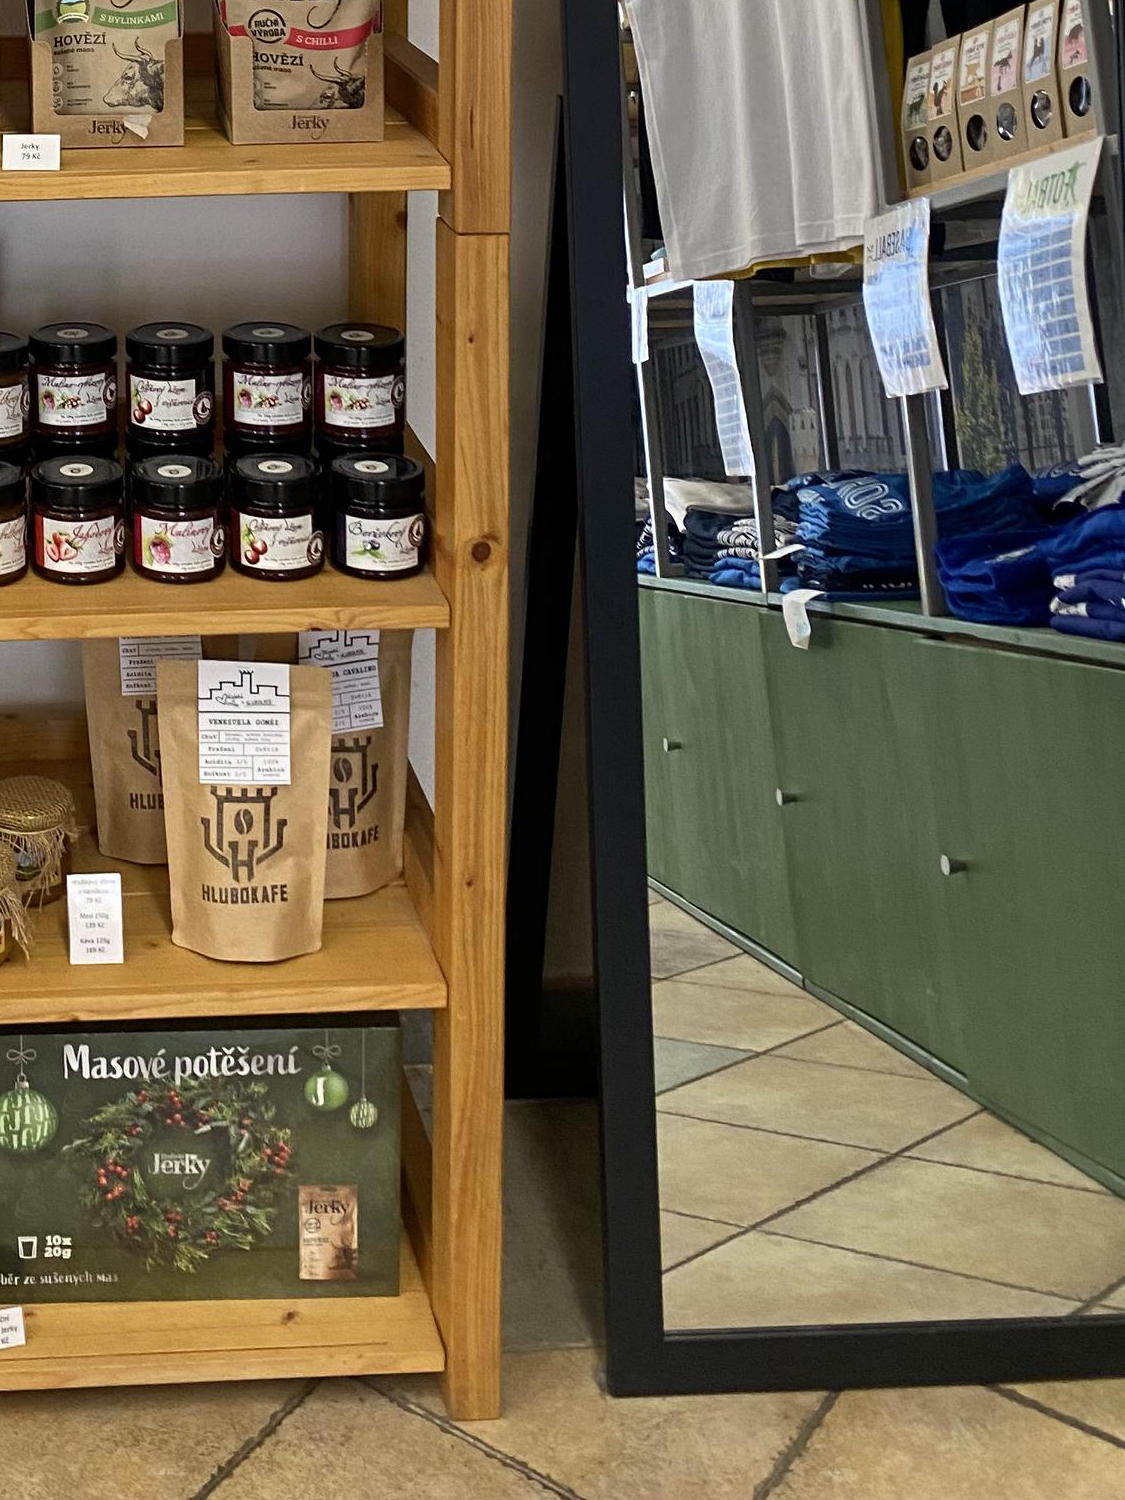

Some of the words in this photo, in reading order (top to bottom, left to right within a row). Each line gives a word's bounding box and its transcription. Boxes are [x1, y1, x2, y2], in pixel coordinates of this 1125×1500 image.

[99, 13, 106, 21] S
[107, 13, 164, 24] BYLINKAMI
[53, 31, 106, 47] HOVĚZÍ
[296, 35, 303, 43] S
[304, 36, 338, 46] CHILLI
[253, 52, 304, 67] HOVĚZÍ
[289, 115, 329, 140] Jerky
[21, 143, 40, 151] Jerky
[201, 884, 288, 905] HLUBOKAFE
[63, 1043, 167, 1082] Masové
[174, 1045, 302, 1084] potěšení
[148, 1152, 211, 1190] Jerky
[45, 1235, 72, 1246] 10x
[44, 1246, 72, 1259] 20g
[23, 1275, 36, 1285] ze
[39, 1271, 93, 1286] sušených
[1, 1326, 18, 1335] Jerky
